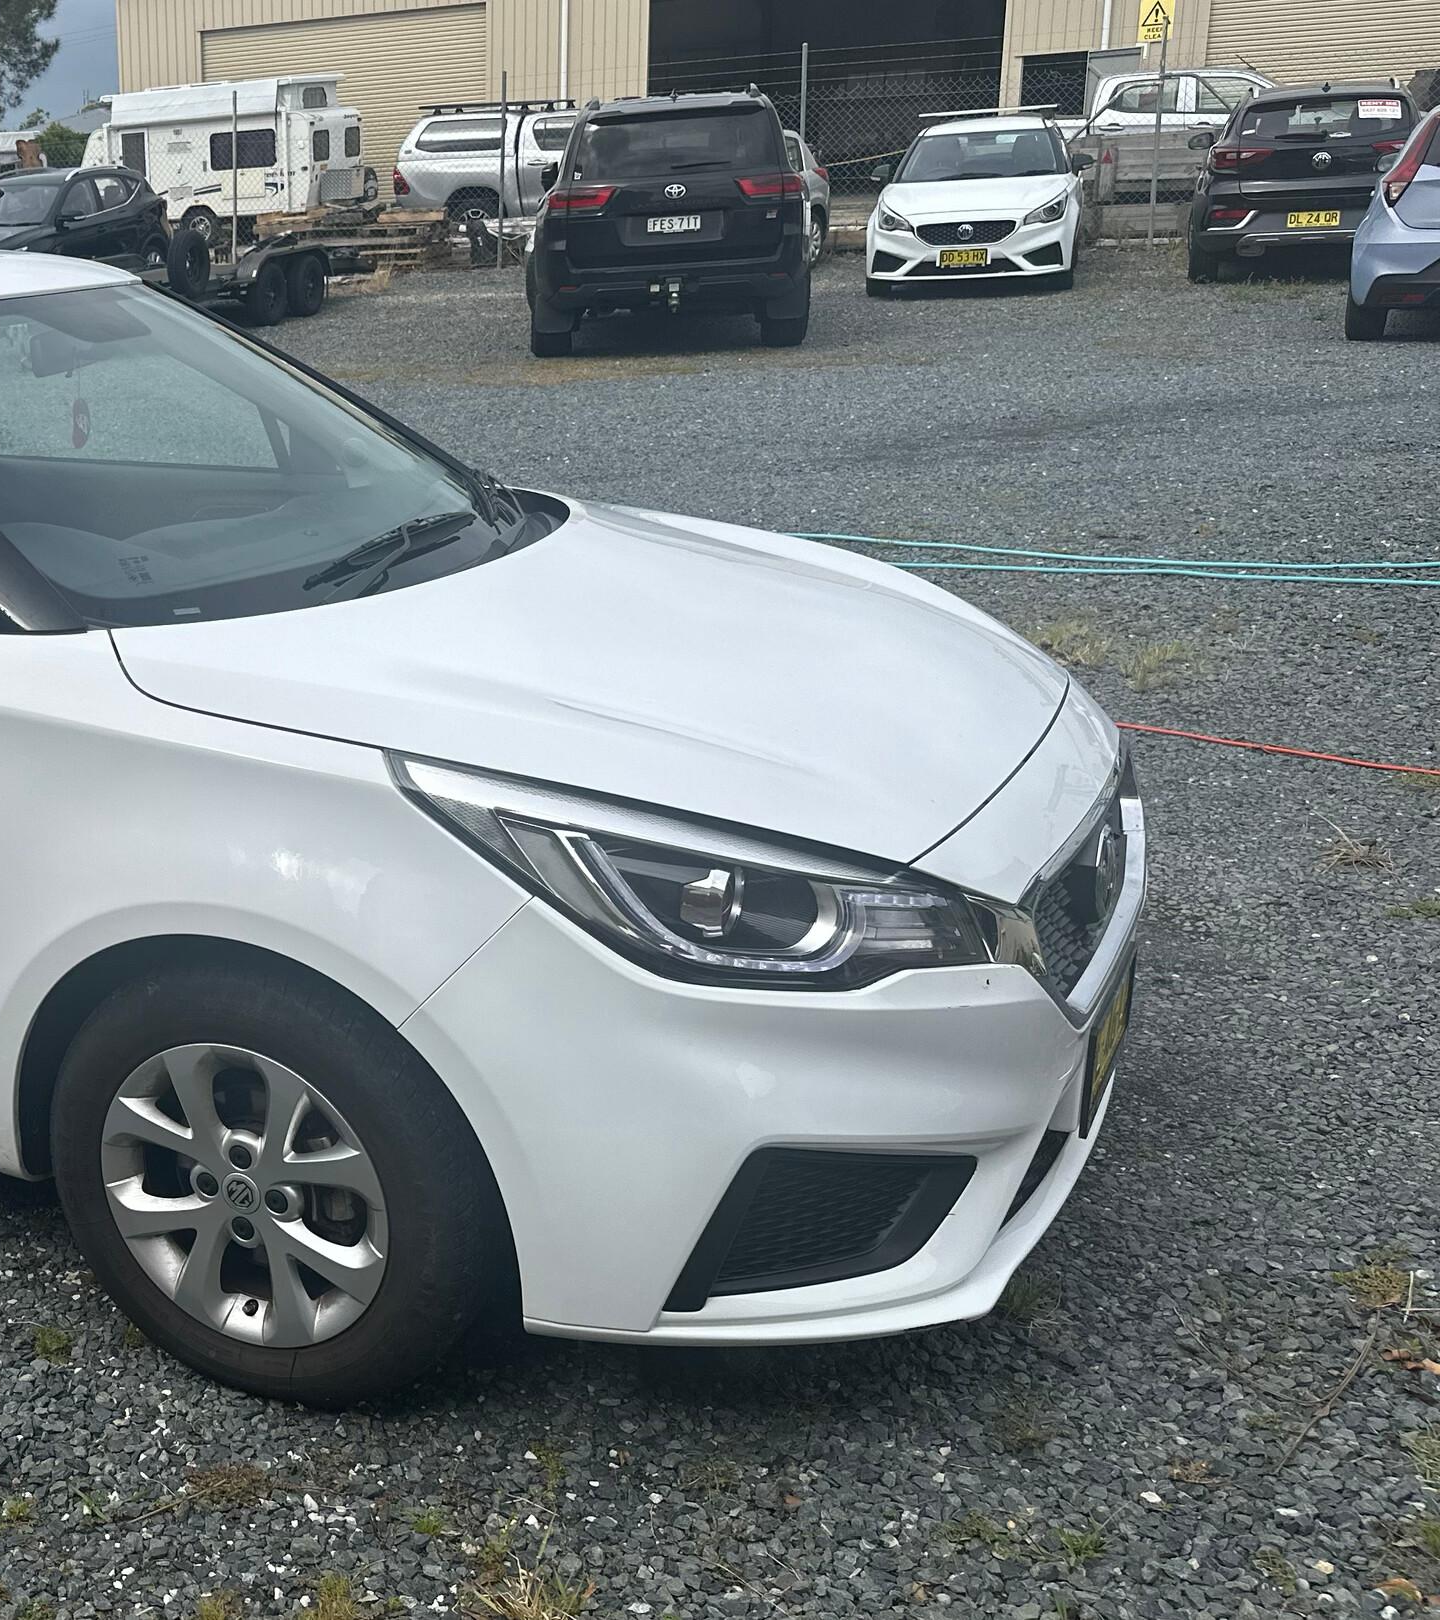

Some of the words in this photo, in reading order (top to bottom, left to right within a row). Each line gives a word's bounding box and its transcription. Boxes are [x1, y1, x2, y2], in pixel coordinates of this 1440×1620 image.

[1289, 213, 1303, 225] DL
[1306, 212, 1320, 224] 24
[957, 252, 969, 262] 53
[972, 251, 984, 261] HX
[227, 1180, 253, 1208] MG
